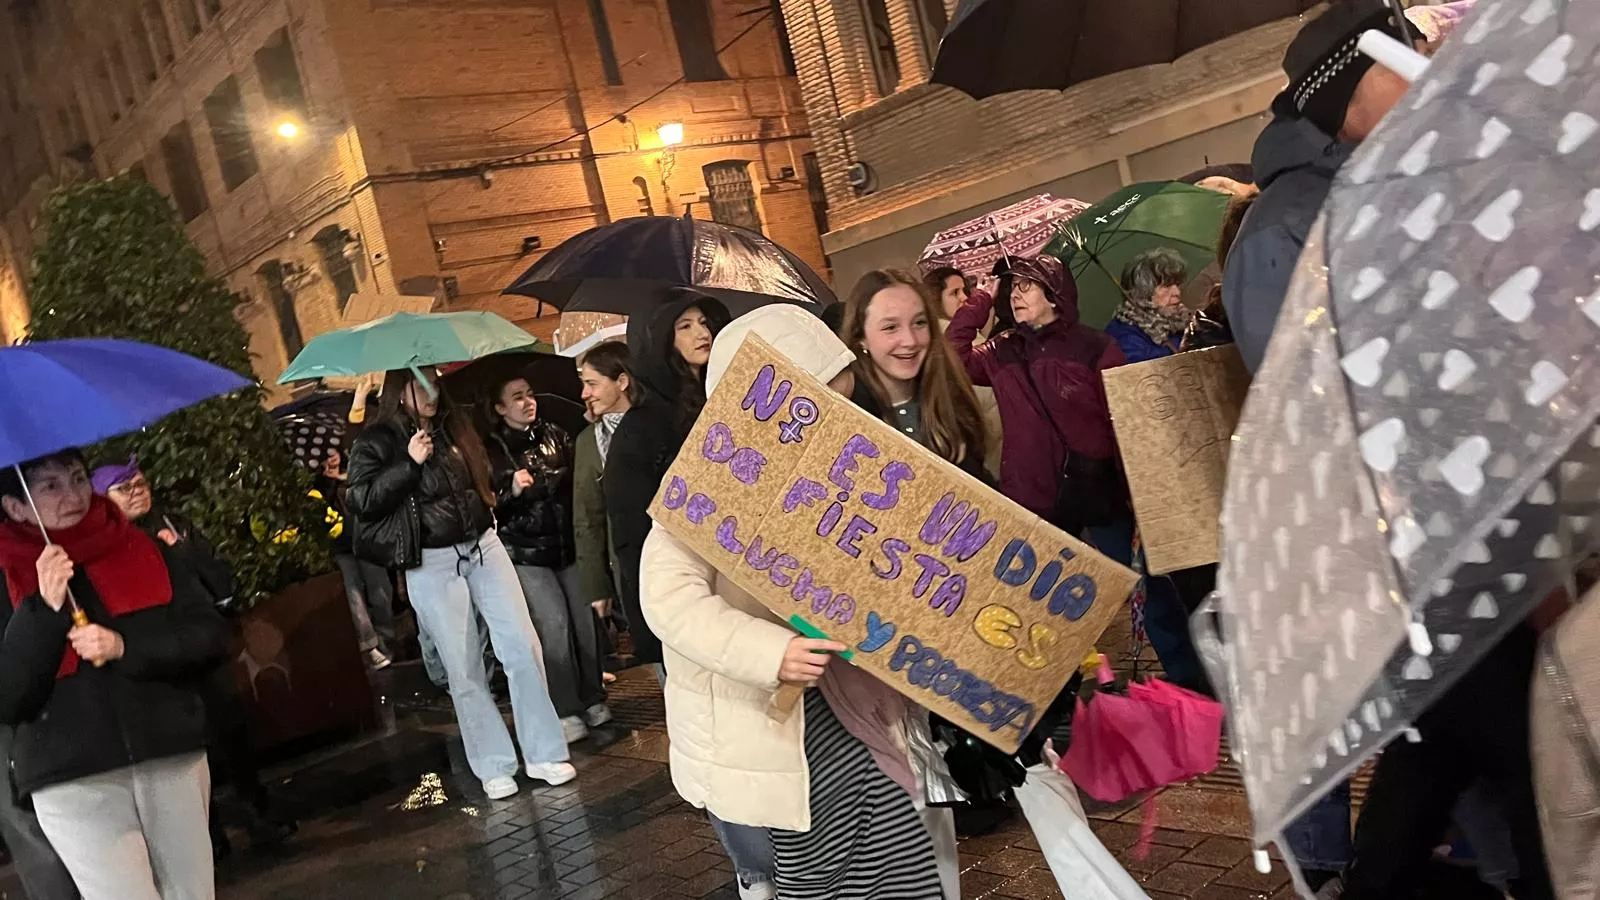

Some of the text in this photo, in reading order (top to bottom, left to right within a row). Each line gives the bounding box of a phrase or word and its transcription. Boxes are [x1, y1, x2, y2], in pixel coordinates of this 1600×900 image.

[1110, 193, 1141, 216] aecc
[828, 434, 916, 510] ES
[716, 516, 858, 625] LUCHA
[973, 603, 1060, 670] ES
